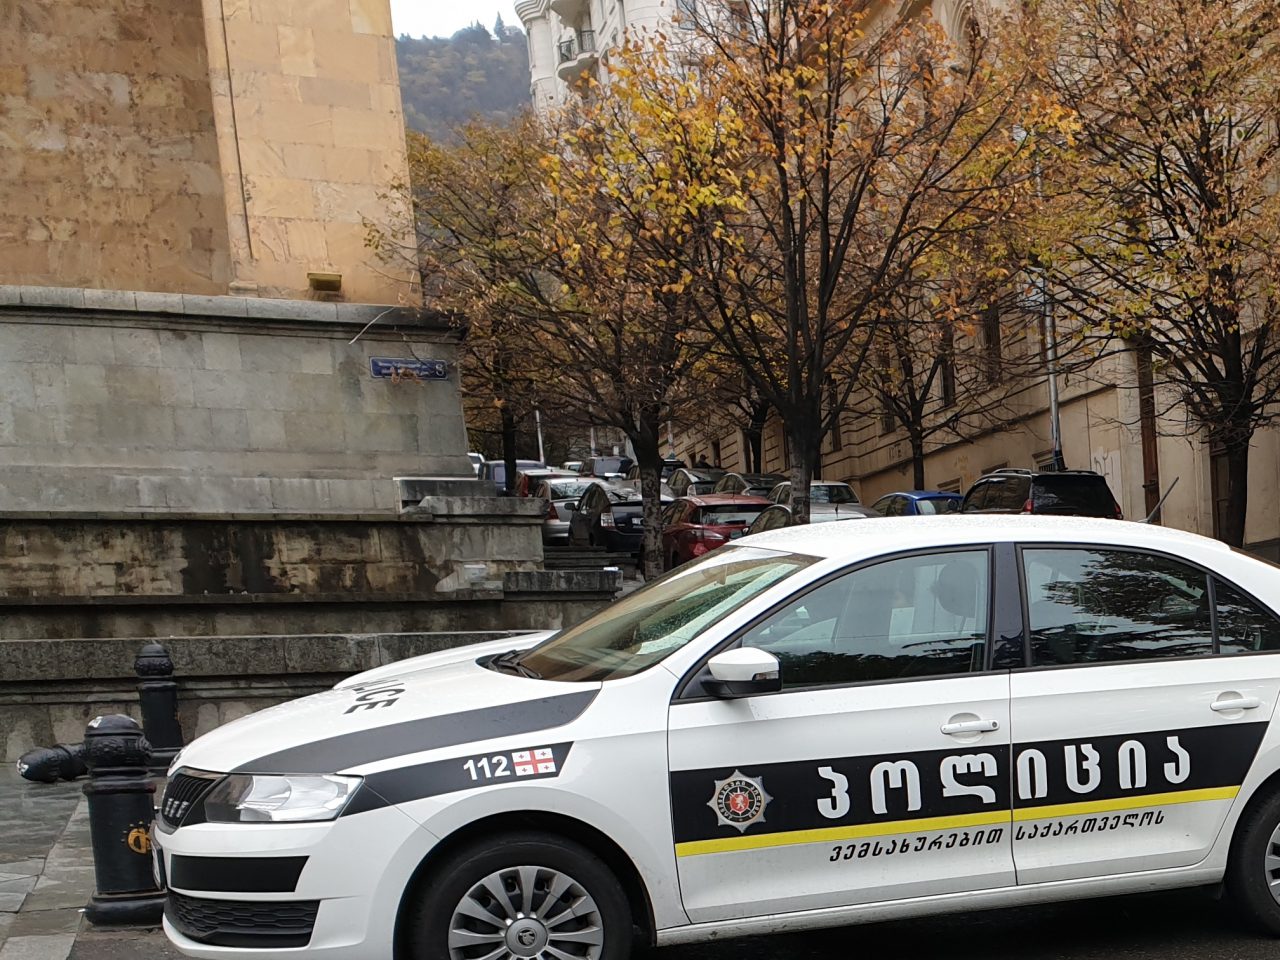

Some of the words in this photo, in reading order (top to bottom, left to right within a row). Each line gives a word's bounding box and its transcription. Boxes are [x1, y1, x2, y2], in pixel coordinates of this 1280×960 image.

[463, 755, 511, 781] 112
[816, 735, 1191, 819] პოლიცია
[829, 827, 1004, 862] ვემსახურებით
[1015, 810, 1165, 841] საქართველოს
